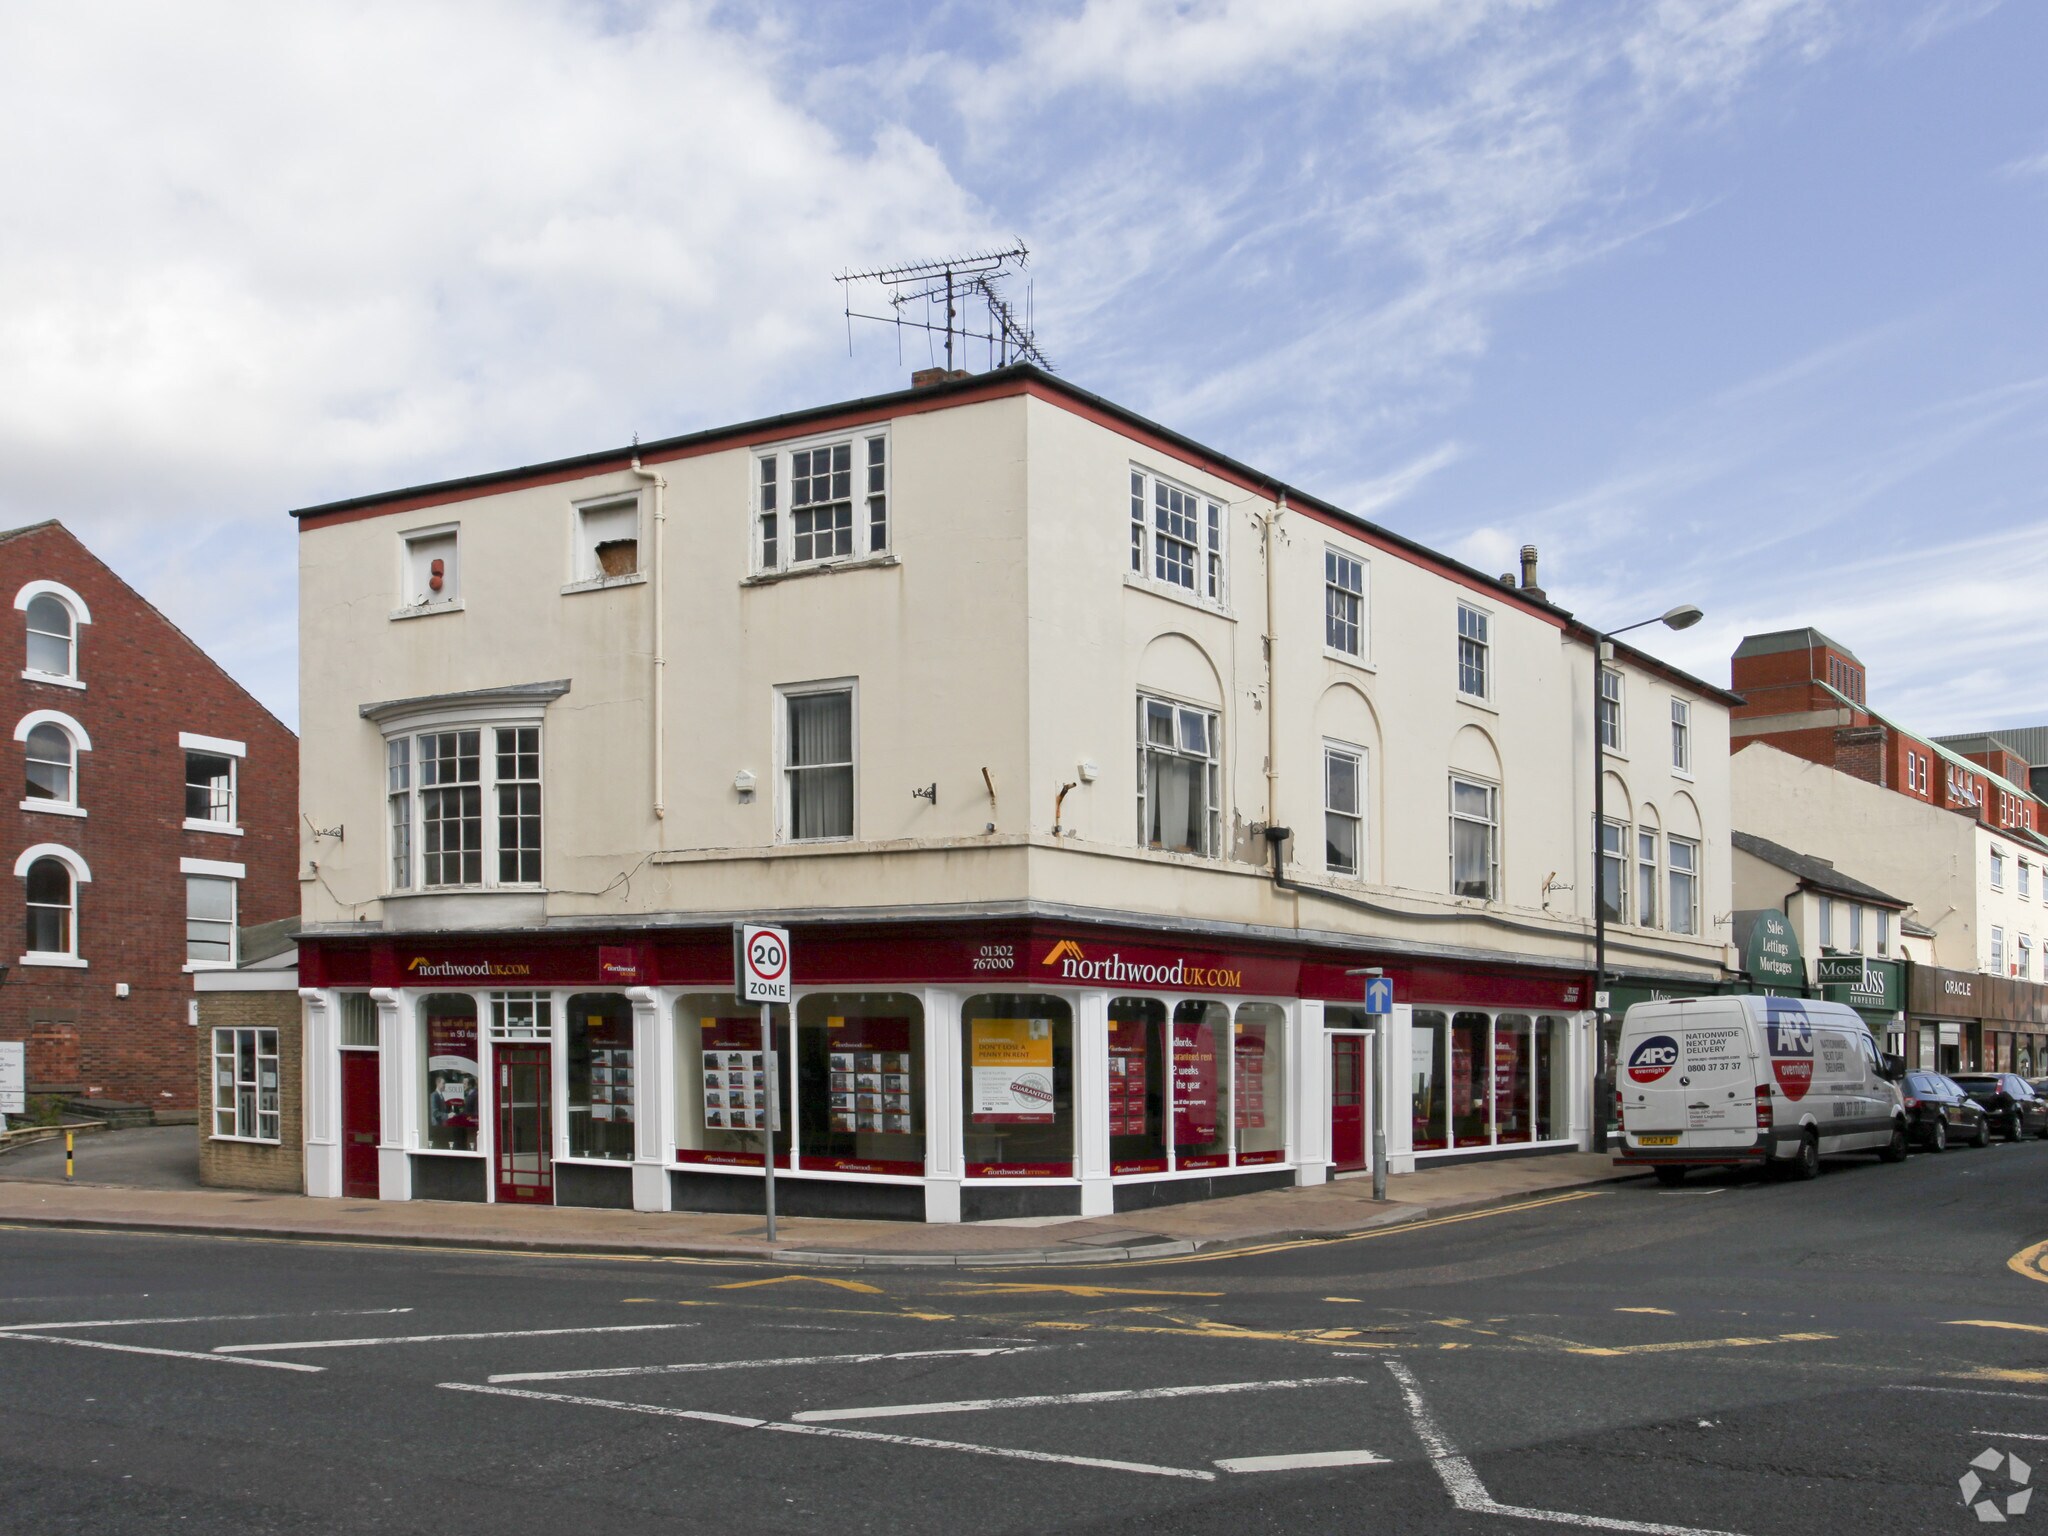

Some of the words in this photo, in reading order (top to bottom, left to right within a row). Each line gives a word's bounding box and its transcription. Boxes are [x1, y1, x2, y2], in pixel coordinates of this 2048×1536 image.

[1767, 919, 1784, 936] Sales
[980, 945, 1014, 956] 01302
[1762, 937, 1789, 957] Lettings
[753, 944, 781, 966] 20
[973, 957, 1015, 970] 767000
[1759, 956, 1792, 976] Mortgages
[1819, 961, 1862, 976] Moss
[750, 982, 786, 997] ZONE
[1944, 980, 1972, 996] ORACLE
[1850, 995, 1885, 1006] PROPERTIES
[456, 1030, 465, 1038] 90
[1686, 1030, 1739, 1040] NATIONWIDE
[1777, 1011, 1814, 1053] APC
[1686, 1046, 1725, 1054] DELIVERY
[1820, 1039, 1848, 1050] NATIONWIDE
[1200, 1053, 1213, 1062] rent
[1635, 1046, 1676, 1065] APC
[1823, 1051, 1836, 1061] NEXT
[1178, 1064, 1199, 1076] weeks
[1634, 1067, 1666, 1075] overnight
[1687, 1064, 1706, 1073] 0800
[1708, 1063, 1718, 1071] 37
[1719, 1063, 1729, 1071] 37
[1731, 1062, 1741, 1070] 37
[1781, 1062, 1811, 1078] overnight
[1825, 1062, 1846, 1073] DELIVERY
[1011, 1083, 1053, 1101] GUARANTEED
[1176, 1080, 1186, 1090] the
[1187, 1081, 1201, 1092] year
[1833, 1102, 1846, 1118] 0800
[1846, 1102, 1853, 1117] 37
[1854, 1101, 1860, 1116] 37
